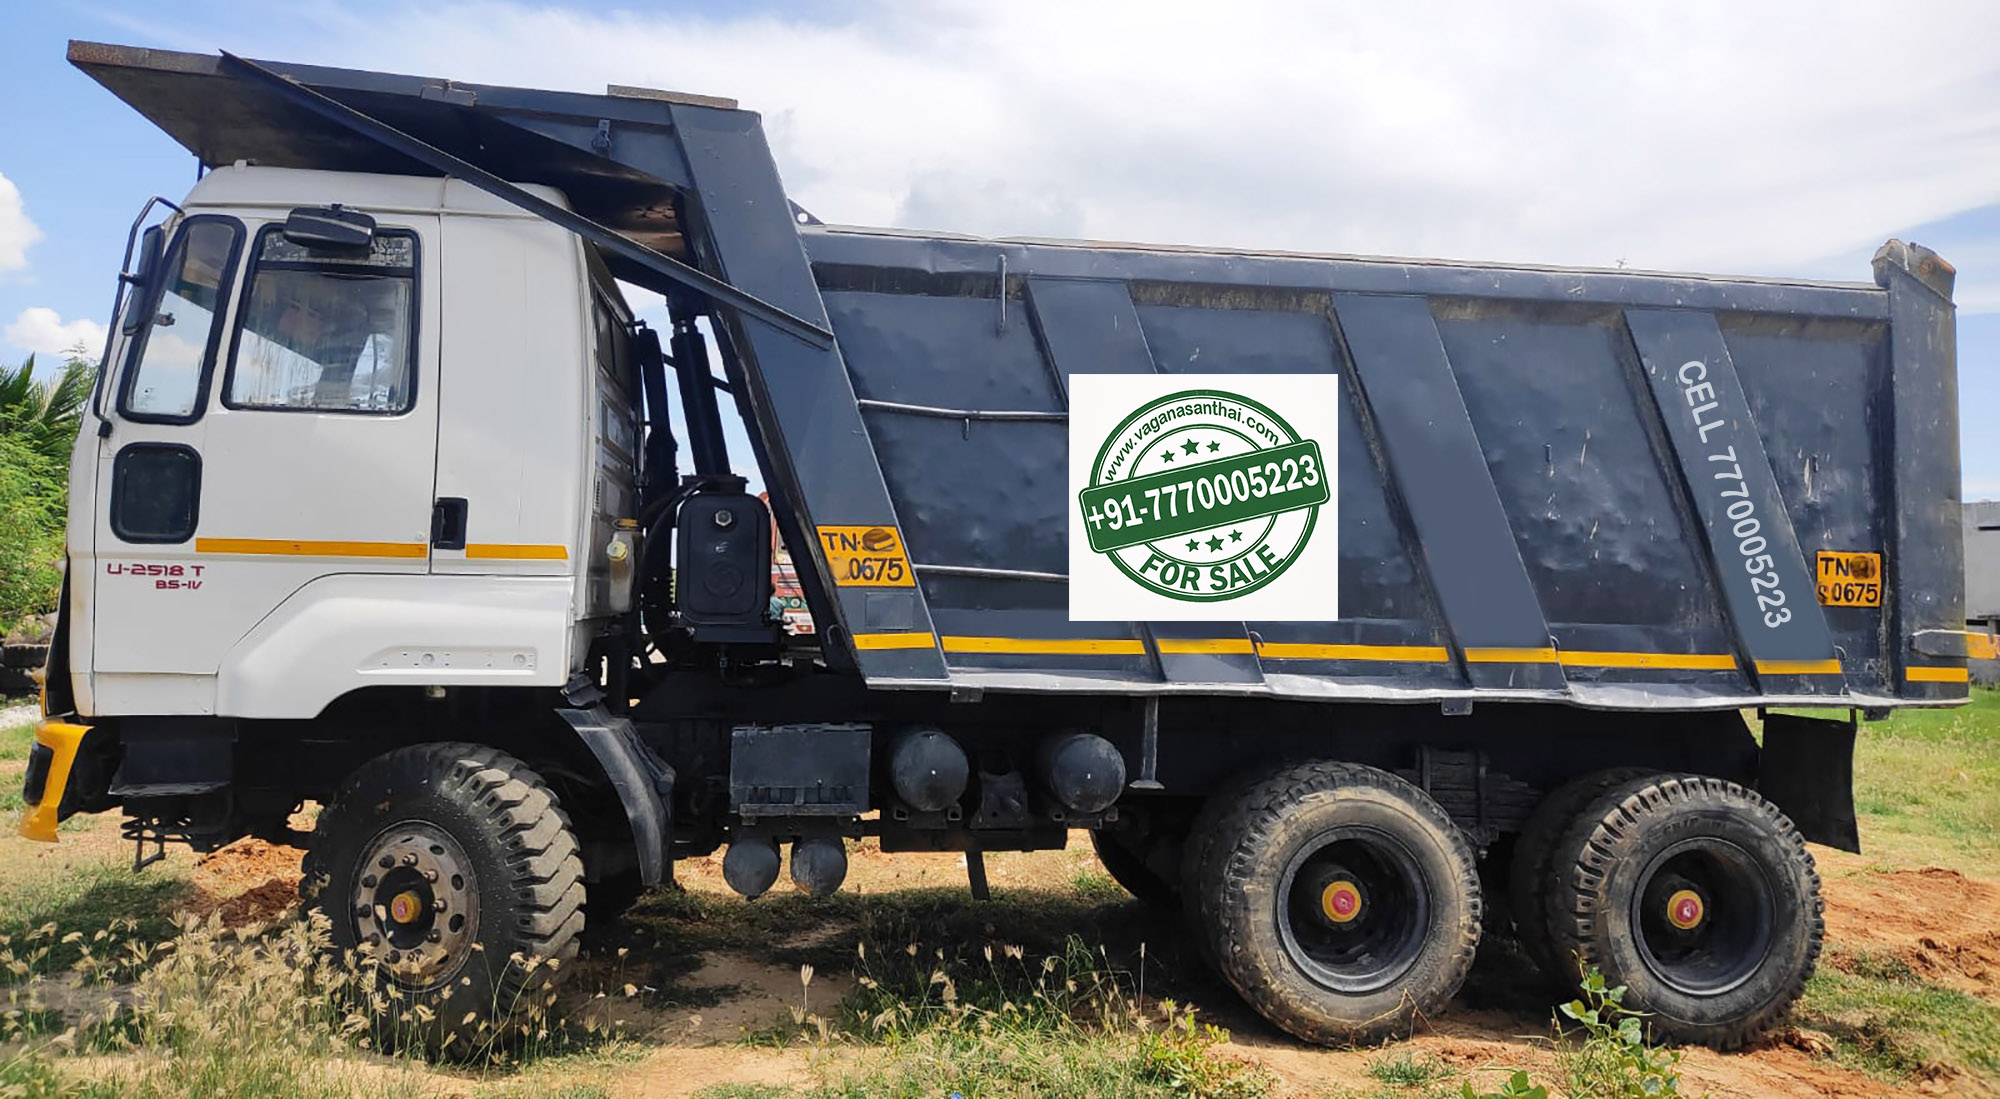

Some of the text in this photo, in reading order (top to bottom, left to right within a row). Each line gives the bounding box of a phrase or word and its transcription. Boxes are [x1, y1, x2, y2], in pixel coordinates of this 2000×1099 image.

[107, 563, 206, 577] U-2518 T
[155, 580, 203, 590] BS-IV
